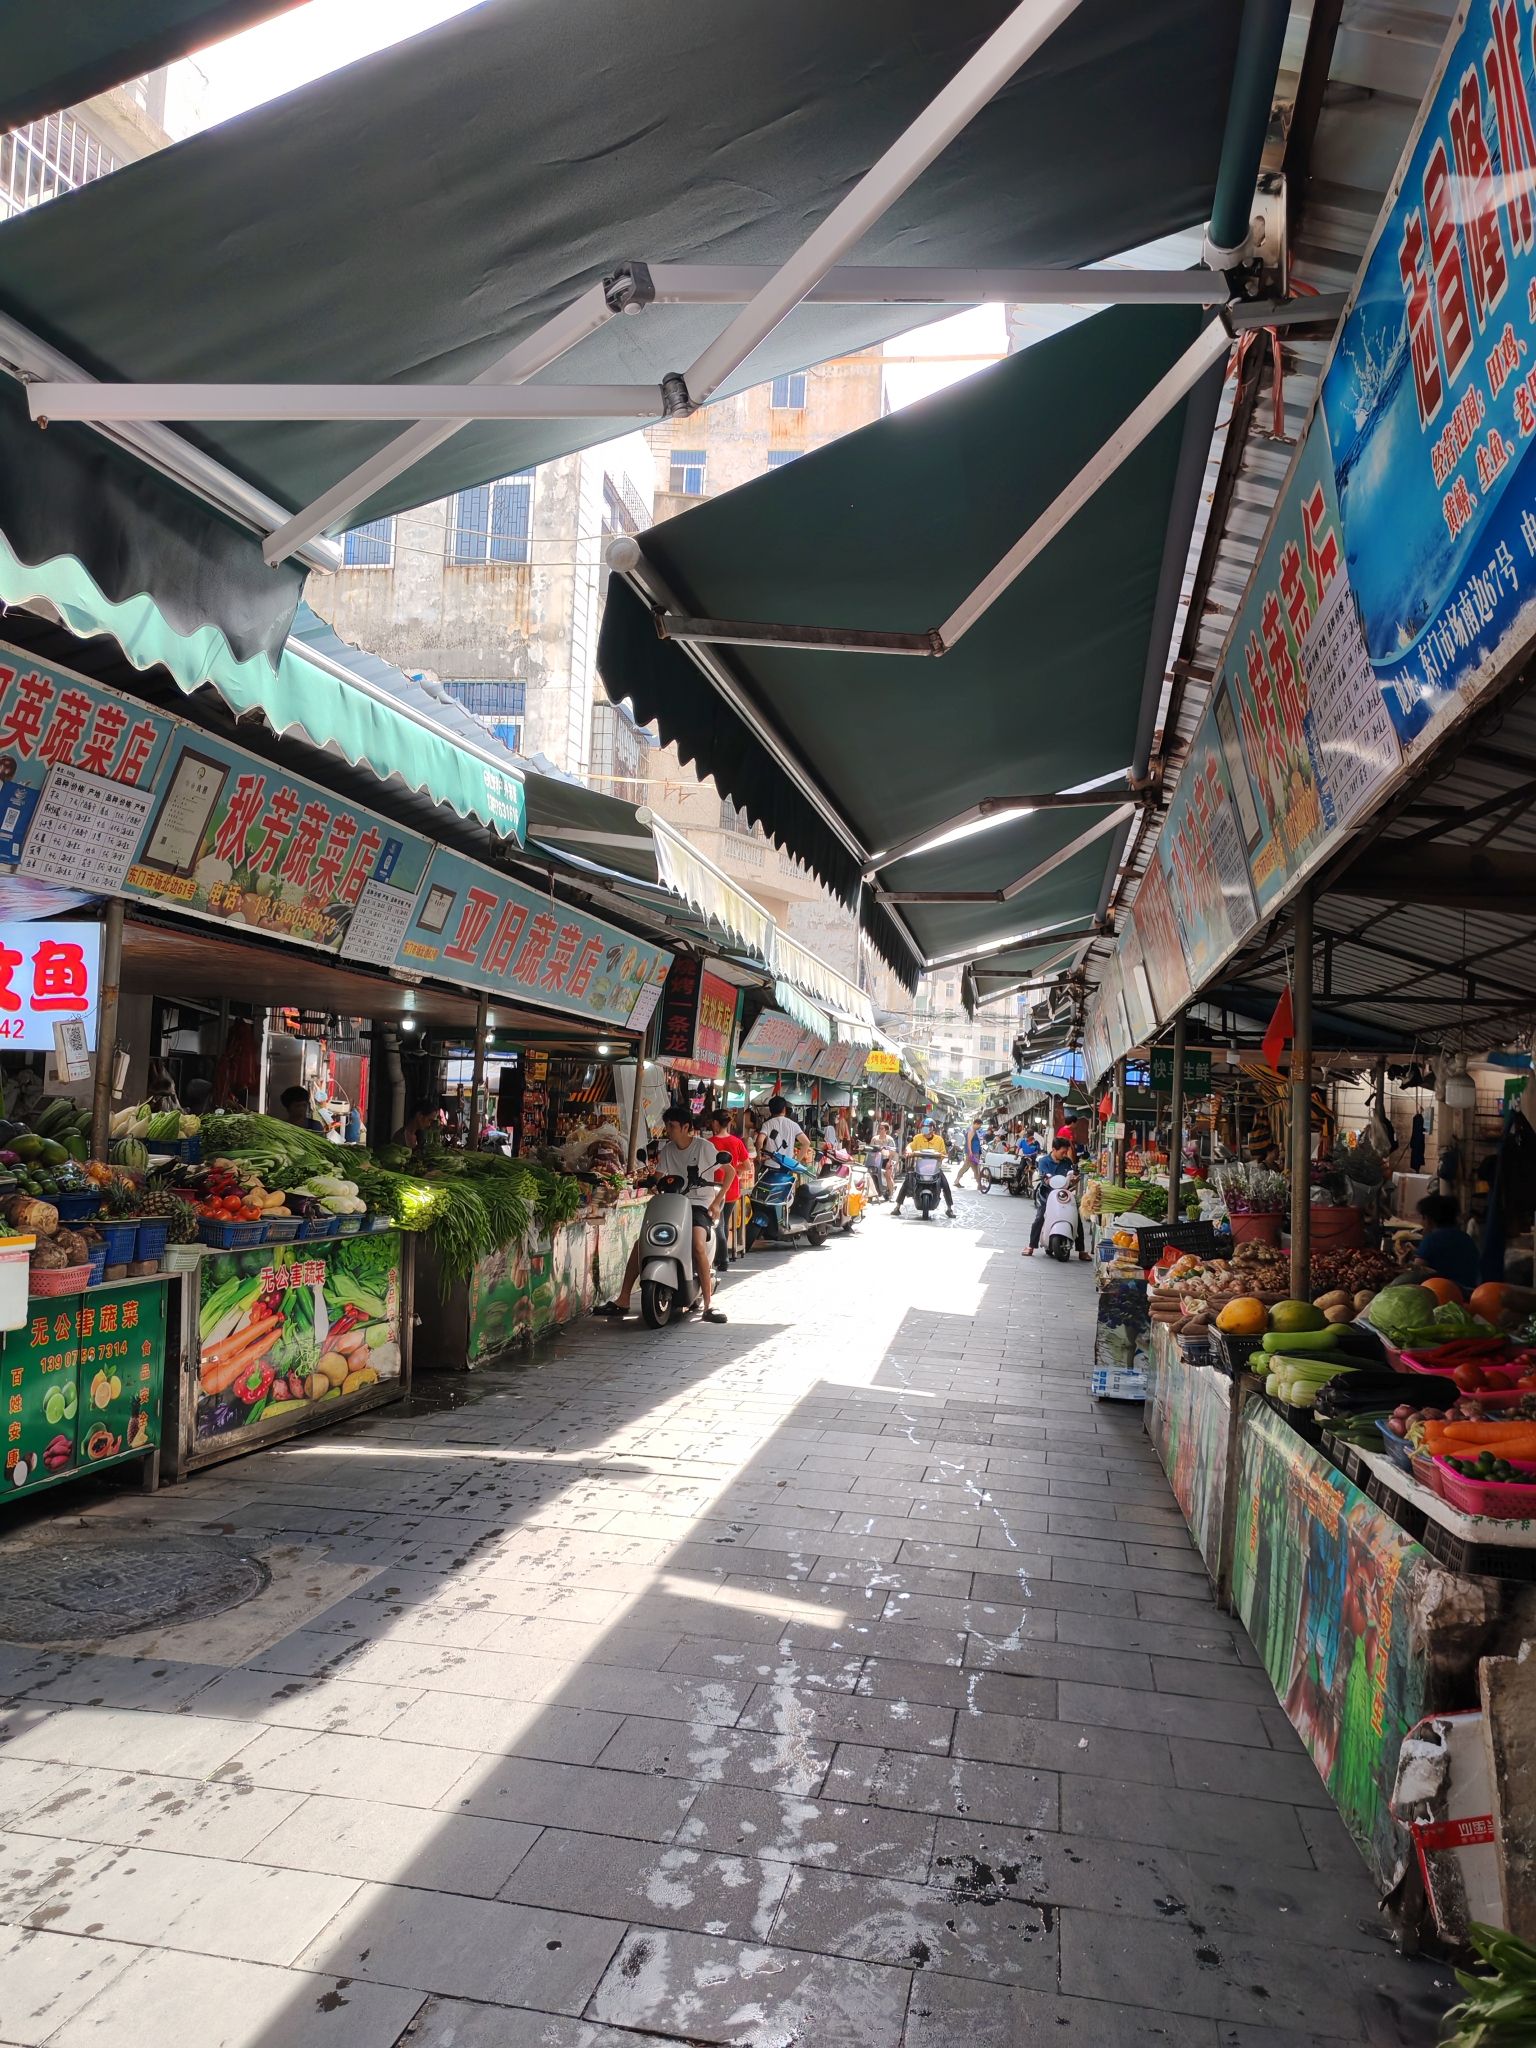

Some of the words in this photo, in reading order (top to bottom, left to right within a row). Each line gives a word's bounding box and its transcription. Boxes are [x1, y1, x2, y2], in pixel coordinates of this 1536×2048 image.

[1399, 0, 1536, 432] 志昌隆水
[127, 866, 198, 901] 东门市场北边61号
[215, 773, 383, 907] 秋芳蔬菜店
[261, 1260, 326, 1293] 无公害蔬菜
[30, 1300, 139, 1347] 无公害蔬菜
[7, 1367, 24, 1468] 百姓安康
[139, 1339, 152, 1430] 食品安全
